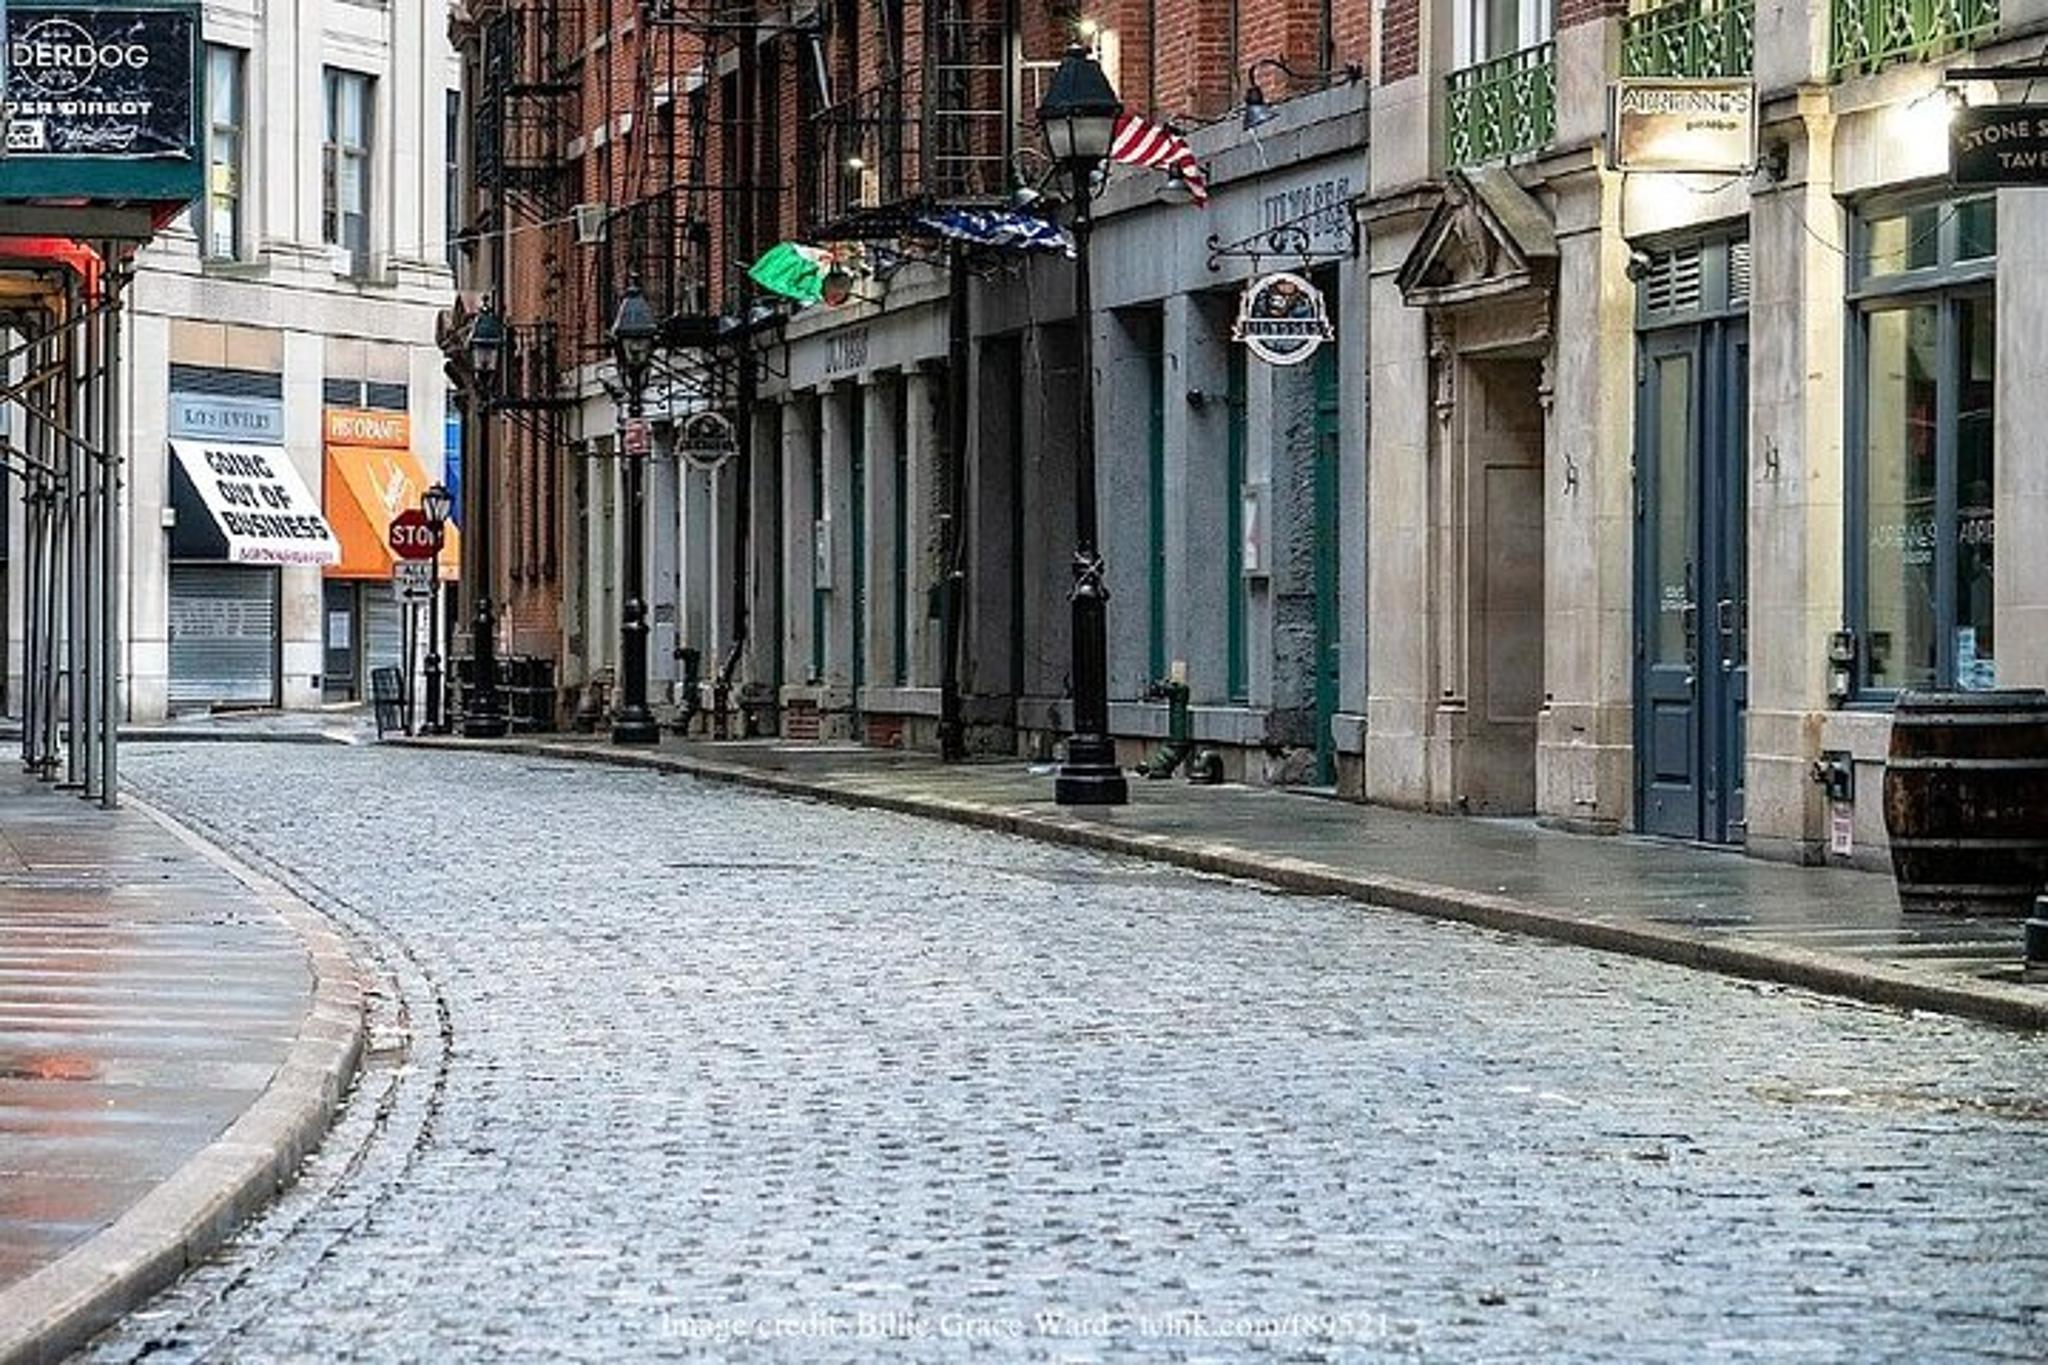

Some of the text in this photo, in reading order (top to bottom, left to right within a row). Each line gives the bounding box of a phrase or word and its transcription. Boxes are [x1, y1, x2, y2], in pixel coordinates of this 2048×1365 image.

[1960, 119, 2031, 152] STONE
[204, 450, 275, 478] GOING
[216, 480, 292, 509] OUT OF
[221, 511, 328, 540] BUSINESS
